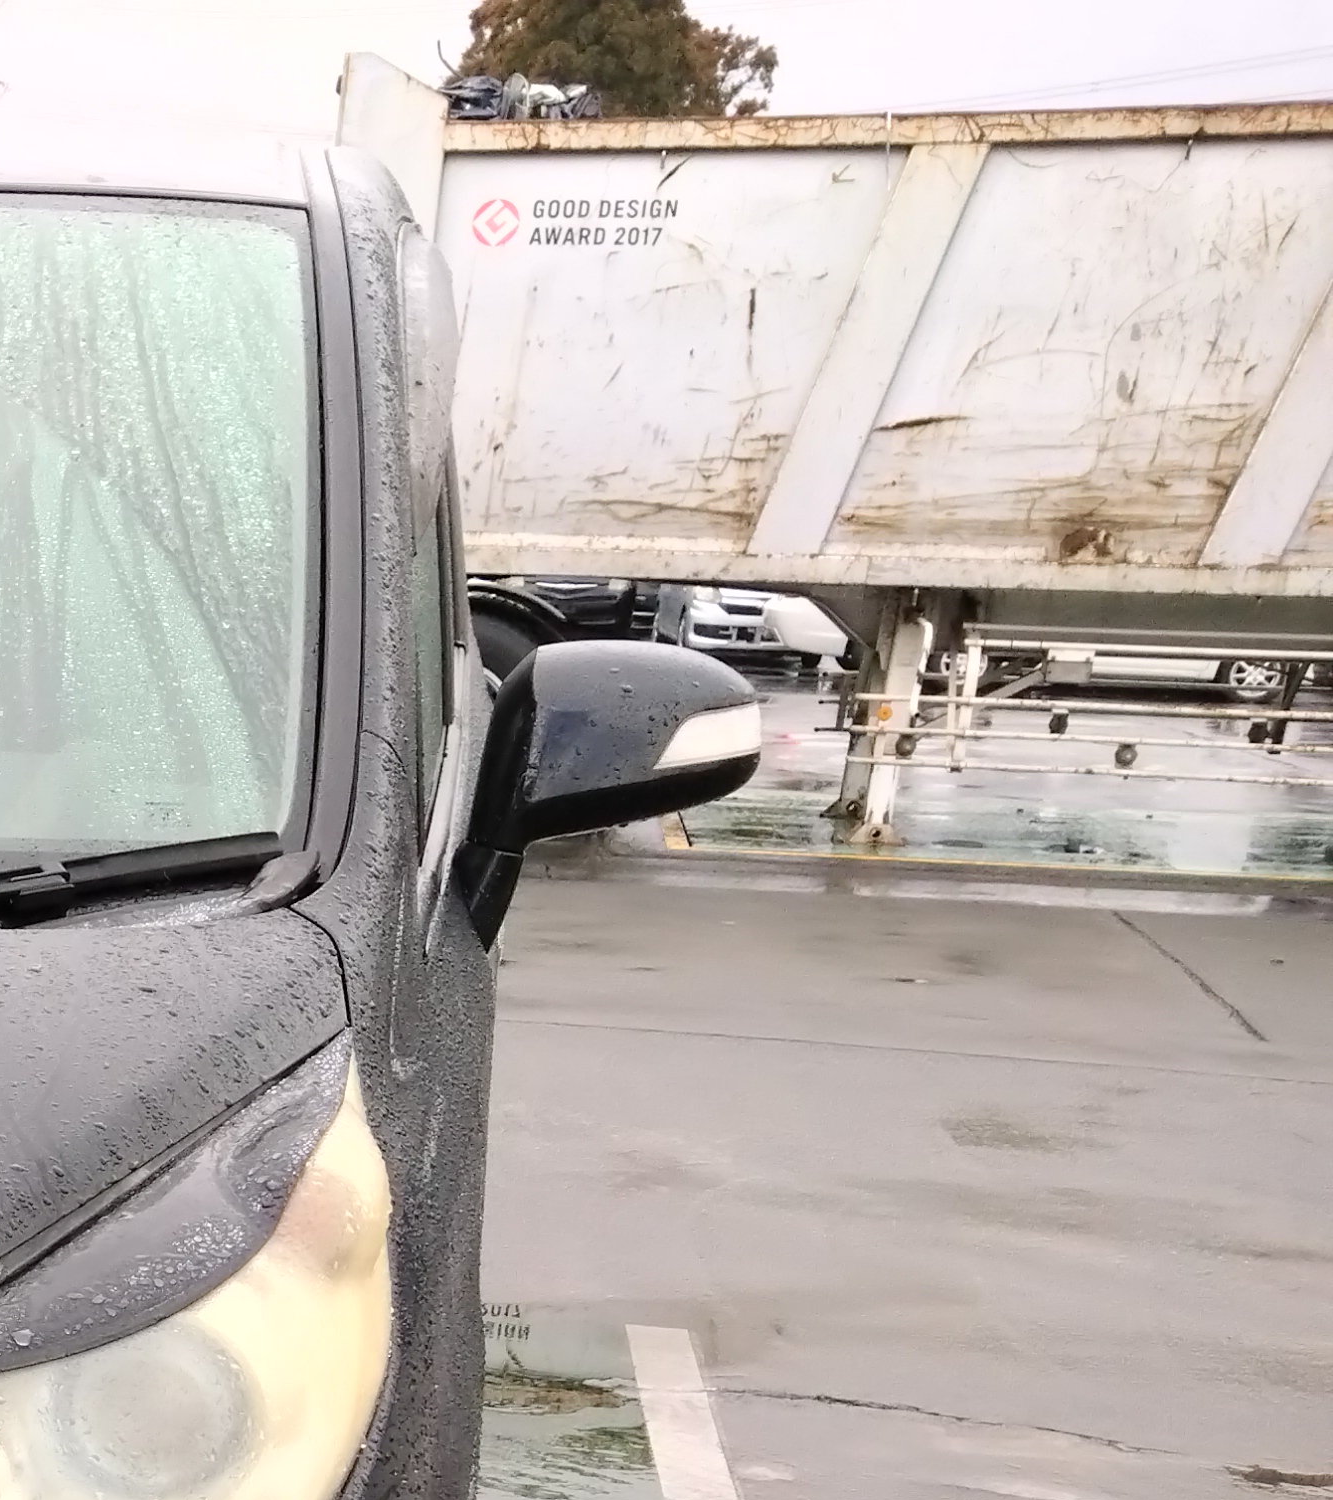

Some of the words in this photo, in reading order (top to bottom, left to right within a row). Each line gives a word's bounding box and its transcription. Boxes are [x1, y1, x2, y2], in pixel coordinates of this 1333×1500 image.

[533, 199, 590, 218] GOOD
[598, 199, 678, 218] DESIGN
[529, 226, 605, 246] AWARD
[614, 226, 663, 246] 2017
